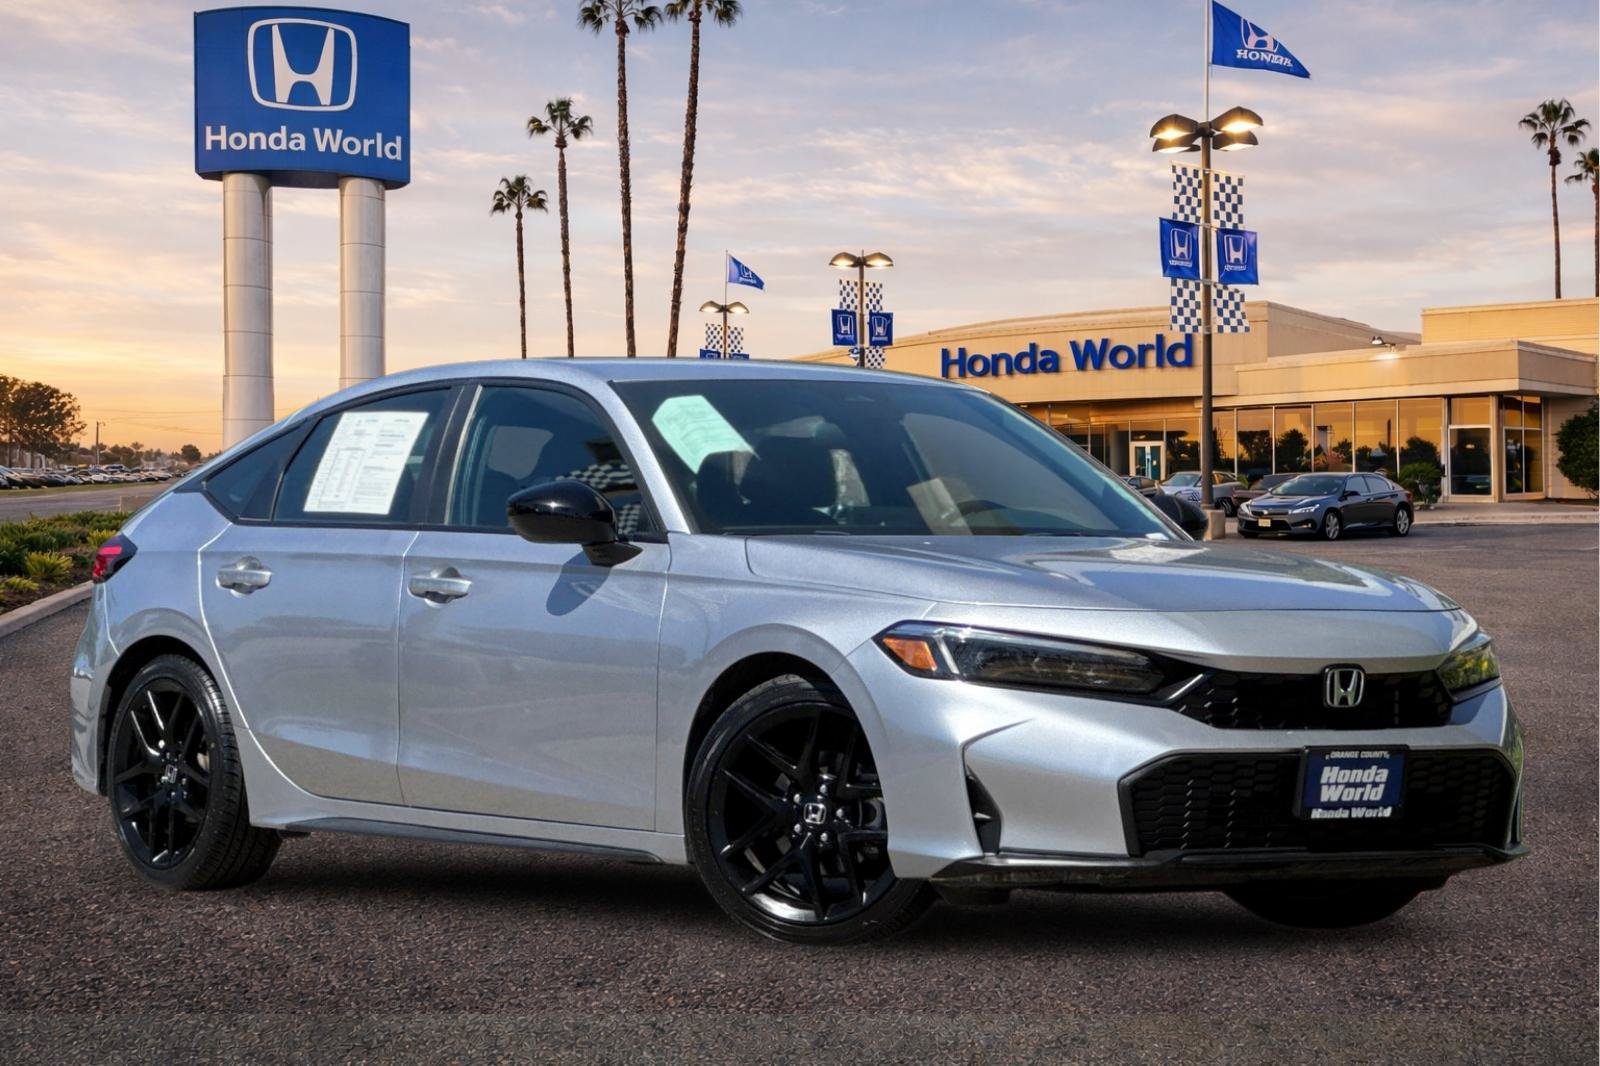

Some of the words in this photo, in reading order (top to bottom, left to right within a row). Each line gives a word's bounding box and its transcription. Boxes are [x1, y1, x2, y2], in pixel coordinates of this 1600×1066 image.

[205, 125, 306, 151] Honda
[312, 127, 402, 161] World
[941, 342, 1060, 378] Honda
[1069, 333, 1193, 370] World
[1320, 765, 1389, 784] Honda
[1320, 784, 1385, 802] World
